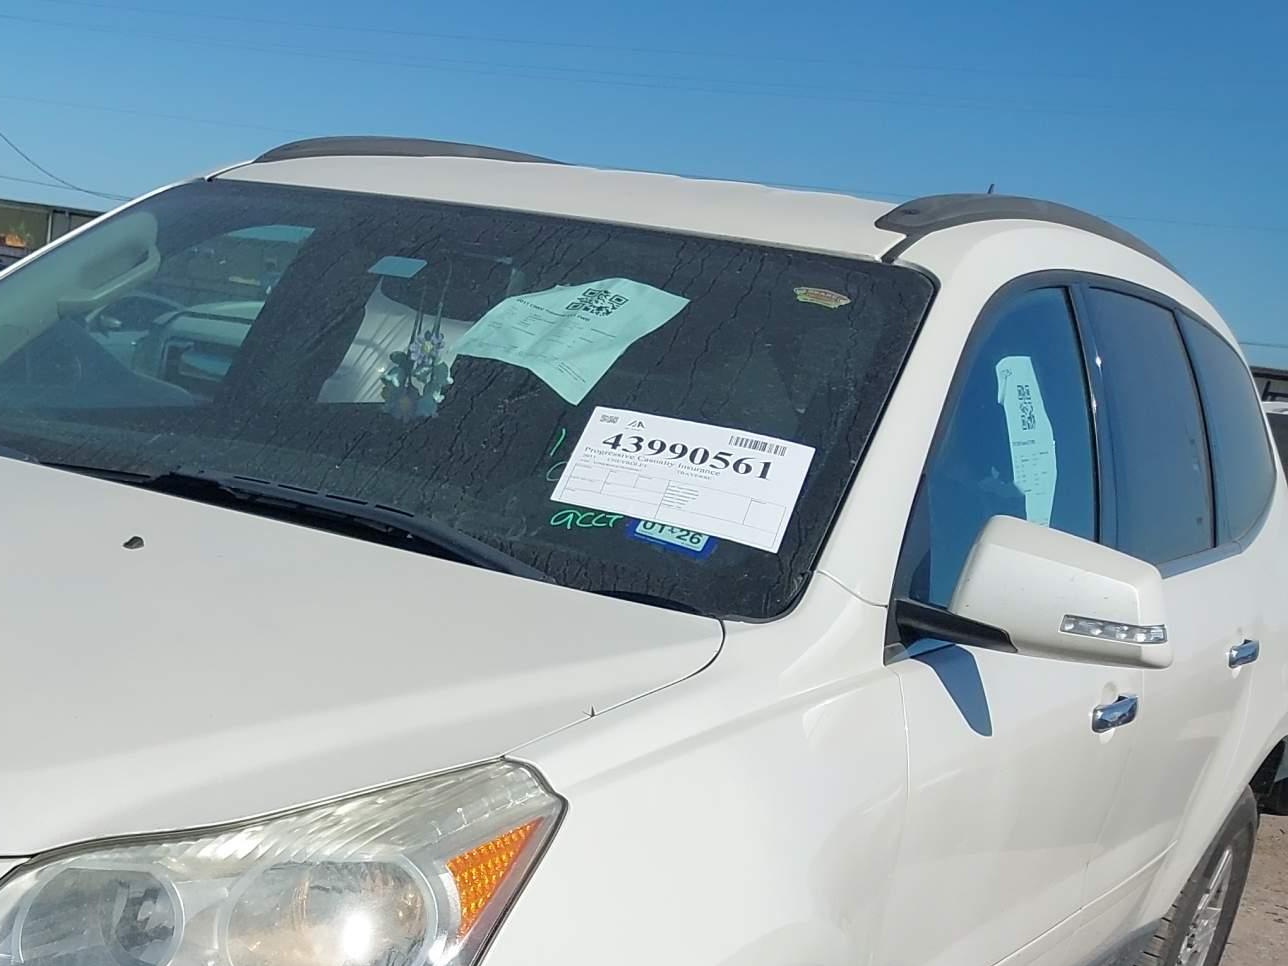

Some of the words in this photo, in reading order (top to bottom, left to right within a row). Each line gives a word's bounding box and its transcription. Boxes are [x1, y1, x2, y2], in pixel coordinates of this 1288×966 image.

[584, 446, 636, 461] Progressive
[637, 455, 674, 469] Casualty
[678, 462, 721, 477] Insurance
[602, 433, 772, 480] 43990561
